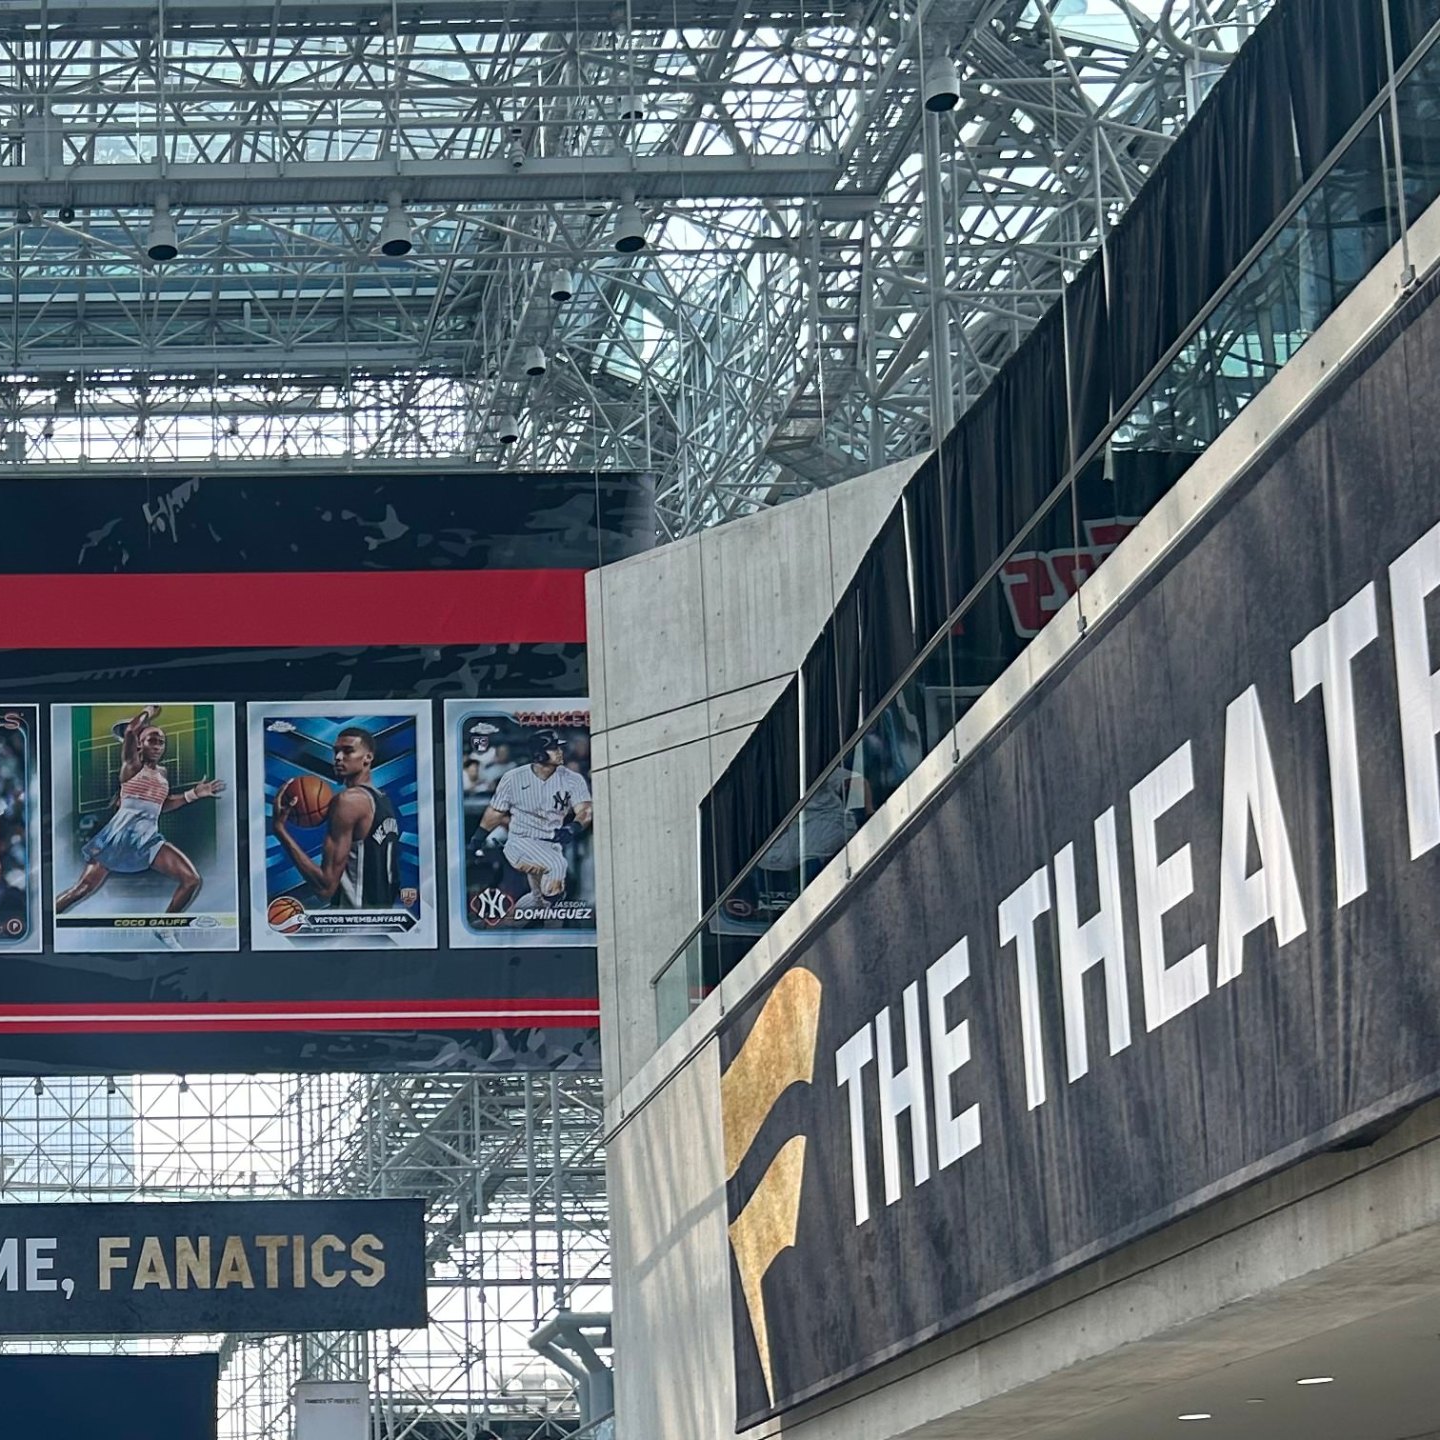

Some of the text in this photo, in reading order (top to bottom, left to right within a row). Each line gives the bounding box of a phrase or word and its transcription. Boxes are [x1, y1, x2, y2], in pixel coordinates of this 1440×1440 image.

[114, 918, 188, 927] COCO GAUFF
[314, 916, 407, 924] VICTOR WEMBANYAMA
[835, 936, 981, 1227] THE
[98, 1233, 386, 1290] FANATICS
